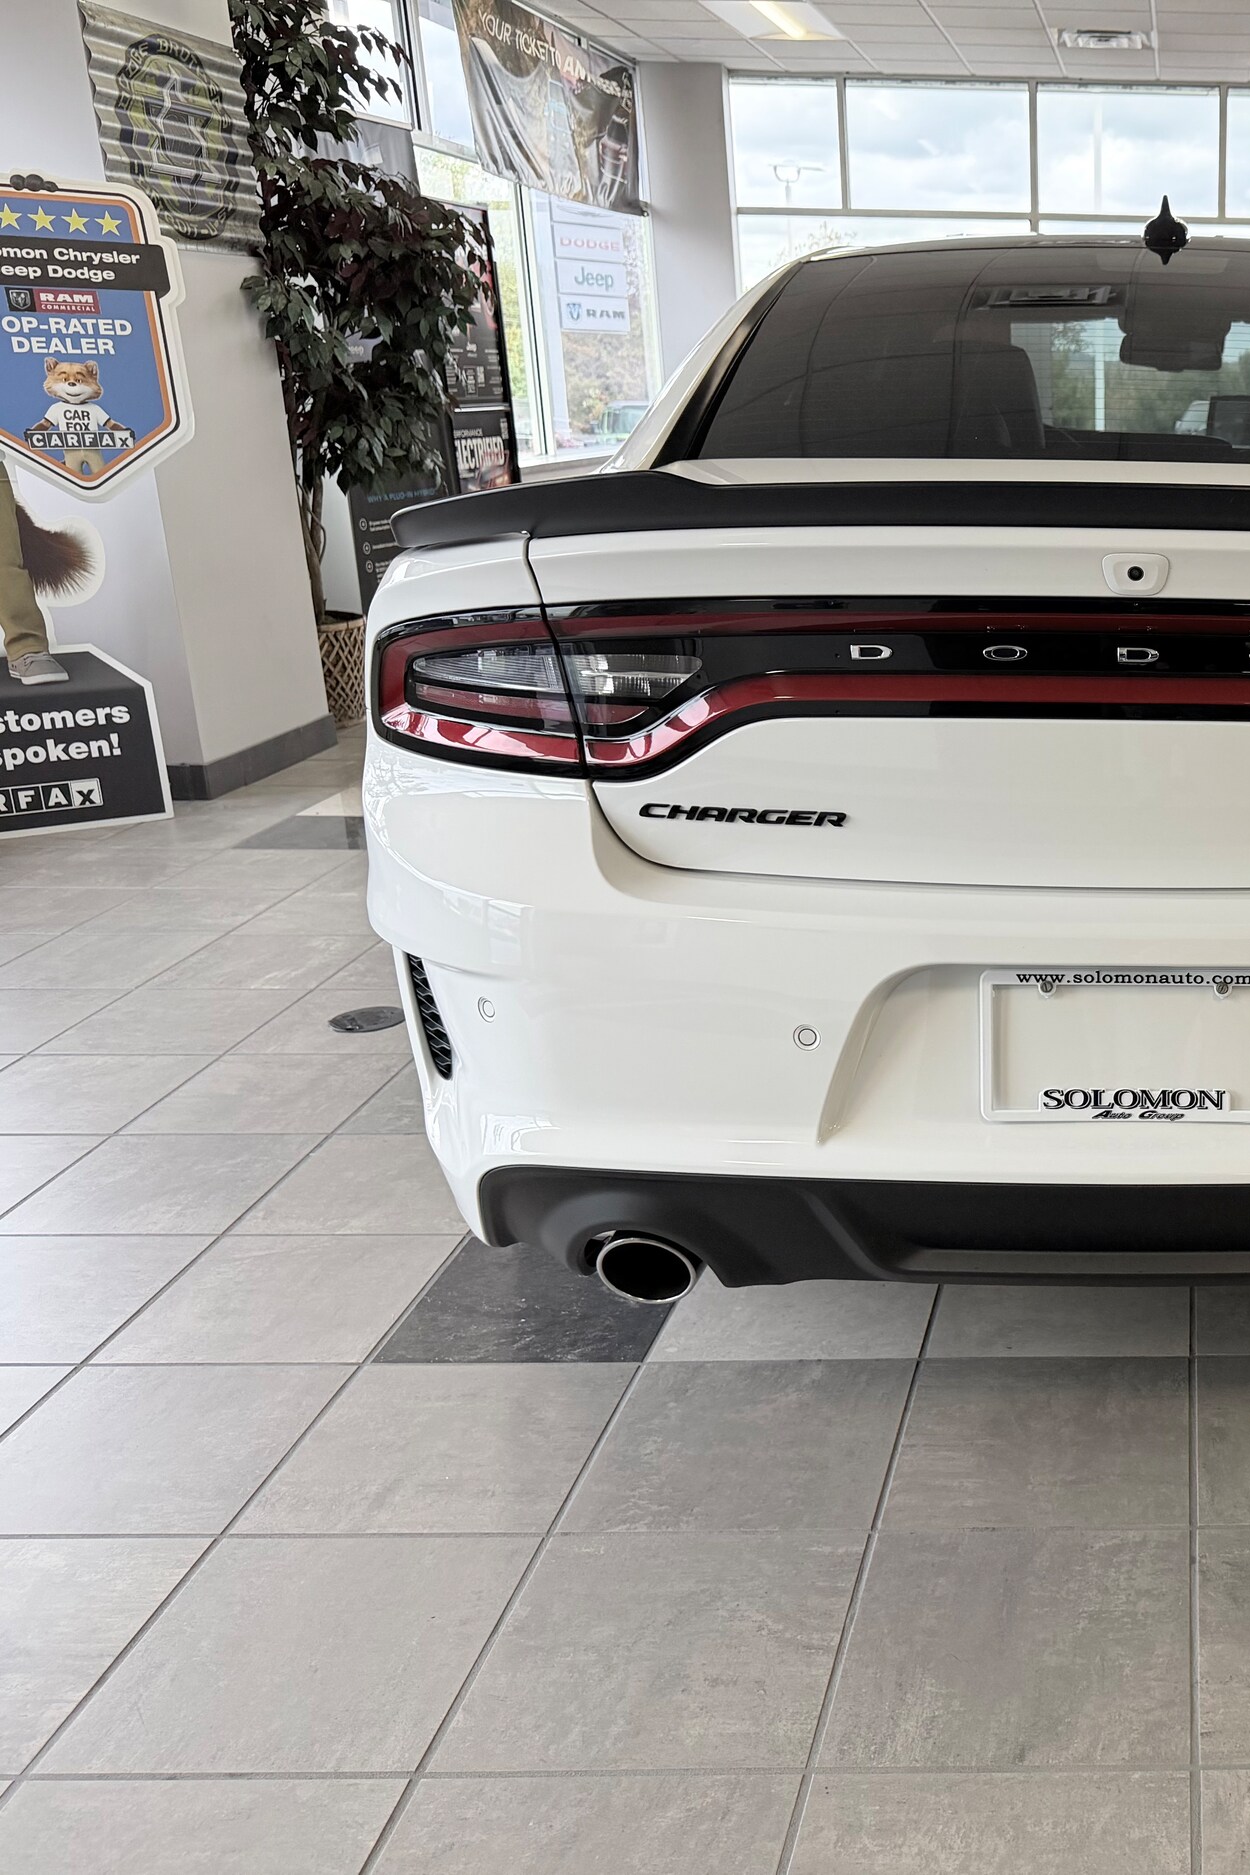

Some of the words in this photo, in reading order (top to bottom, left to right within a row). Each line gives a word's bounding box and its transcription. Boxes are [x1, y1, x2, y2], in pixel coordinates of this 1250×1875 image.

[478, 9, 511, 46] YOUR
[515, 25, 549, 62] TICKET
[560, 237, 619, 252] DODGE
[0, 247, 48, 260] mon
[53, 247, 141, 265] Chrysler
[0, 265, 42, 279] eep
[47, 265, 116, 282] Dodge
[574, 266, 614, 291] Jeep
[39, 292, 94, 303] RAM
[41, 304, 96, 312] COMMERCIAL
[586, 308, 625, 320] RAM
[1, 315, 133, 336] OP-RATED
[11, 336, 116, 355] DEALER
[63, 409, 91, 421] CAR
[66, 421, 91, 431] FOX
[31, 432, 131, 448] CARFAX
[0, 704, 131, 734] tomers
[0, 733, 122, 771] poken!
[638, 802, 848, 828] CHARGER
[1043, 1089, 1226, 1110] SOLOMON
[1091, 1110, 1132, 1120] Auto
[1138, 1110, 1185, 1122] Group
